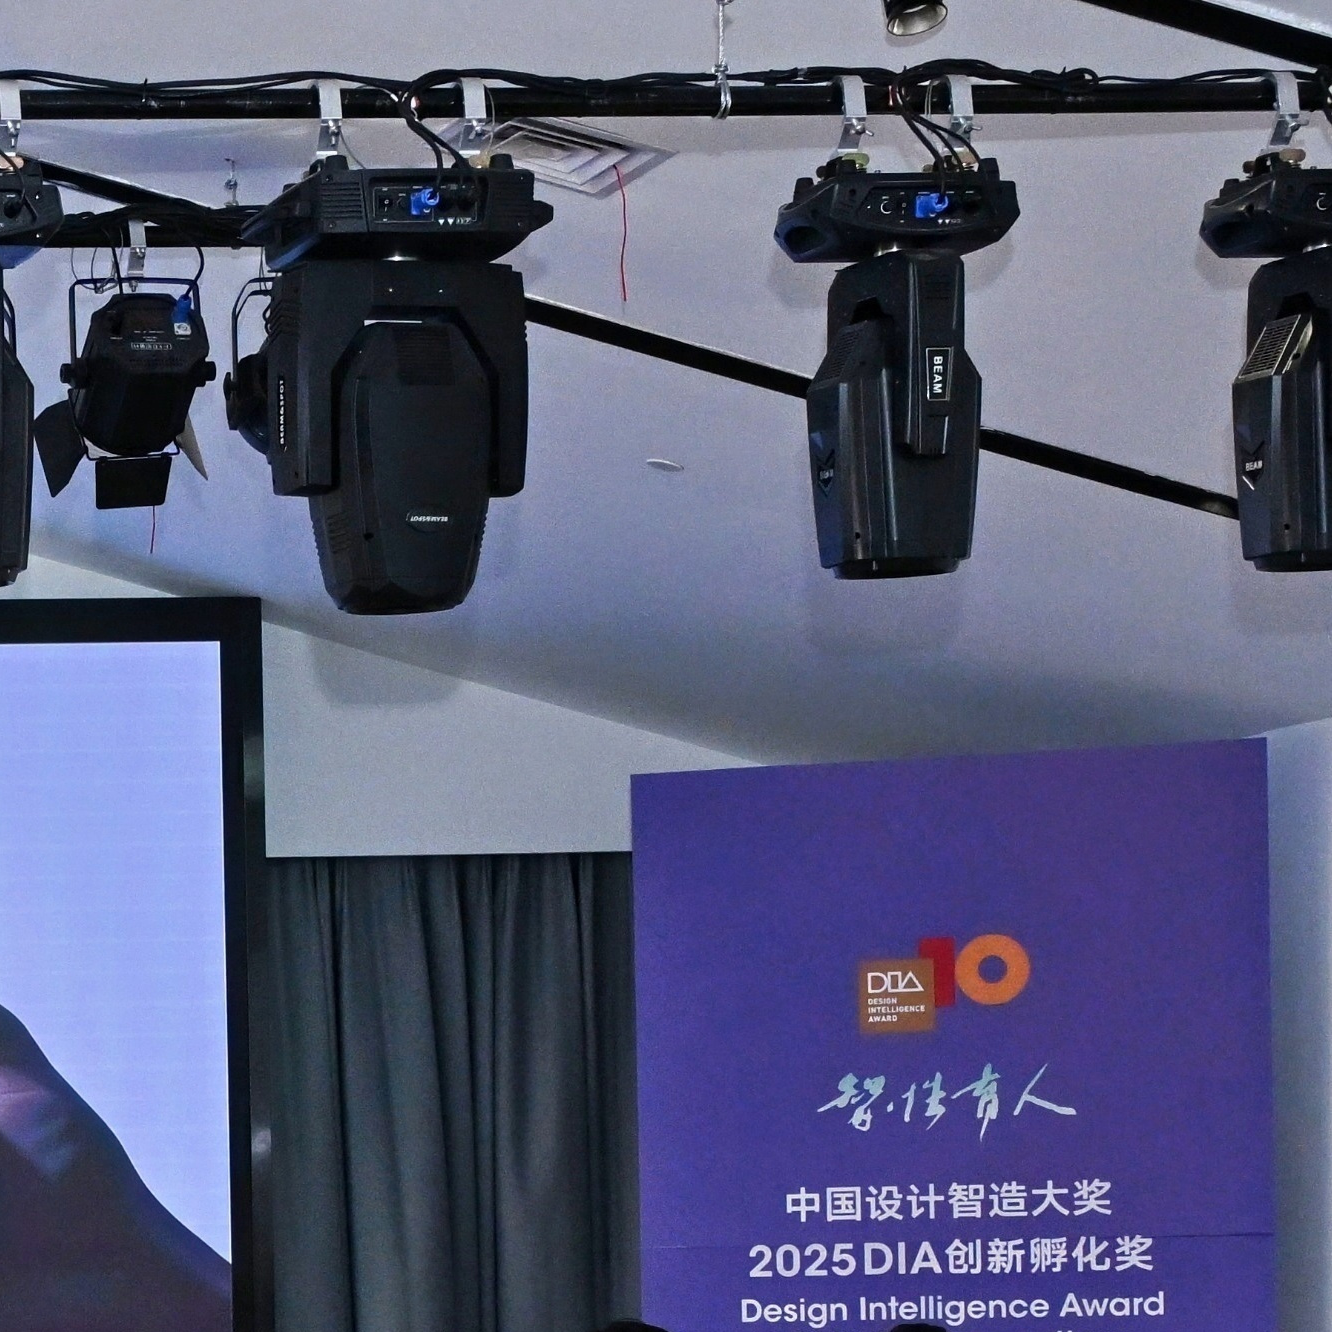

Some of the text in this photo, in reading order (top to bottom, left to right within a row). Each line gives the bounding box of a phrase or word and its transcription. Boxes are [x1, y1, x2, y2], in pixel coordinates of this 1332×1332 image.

[932, 355, 943, 395] BEAM
[867, 997, 898, 1005] DESIGN
[867, 1005, 926, 1013] INTELLIGENCE
[867, 1014, 898, 1022] AWARD
[785, 1178, 1113, 1223] 中国设计智造大奖
[741, 1291, 1165, 1329] Design Intelligence Award
